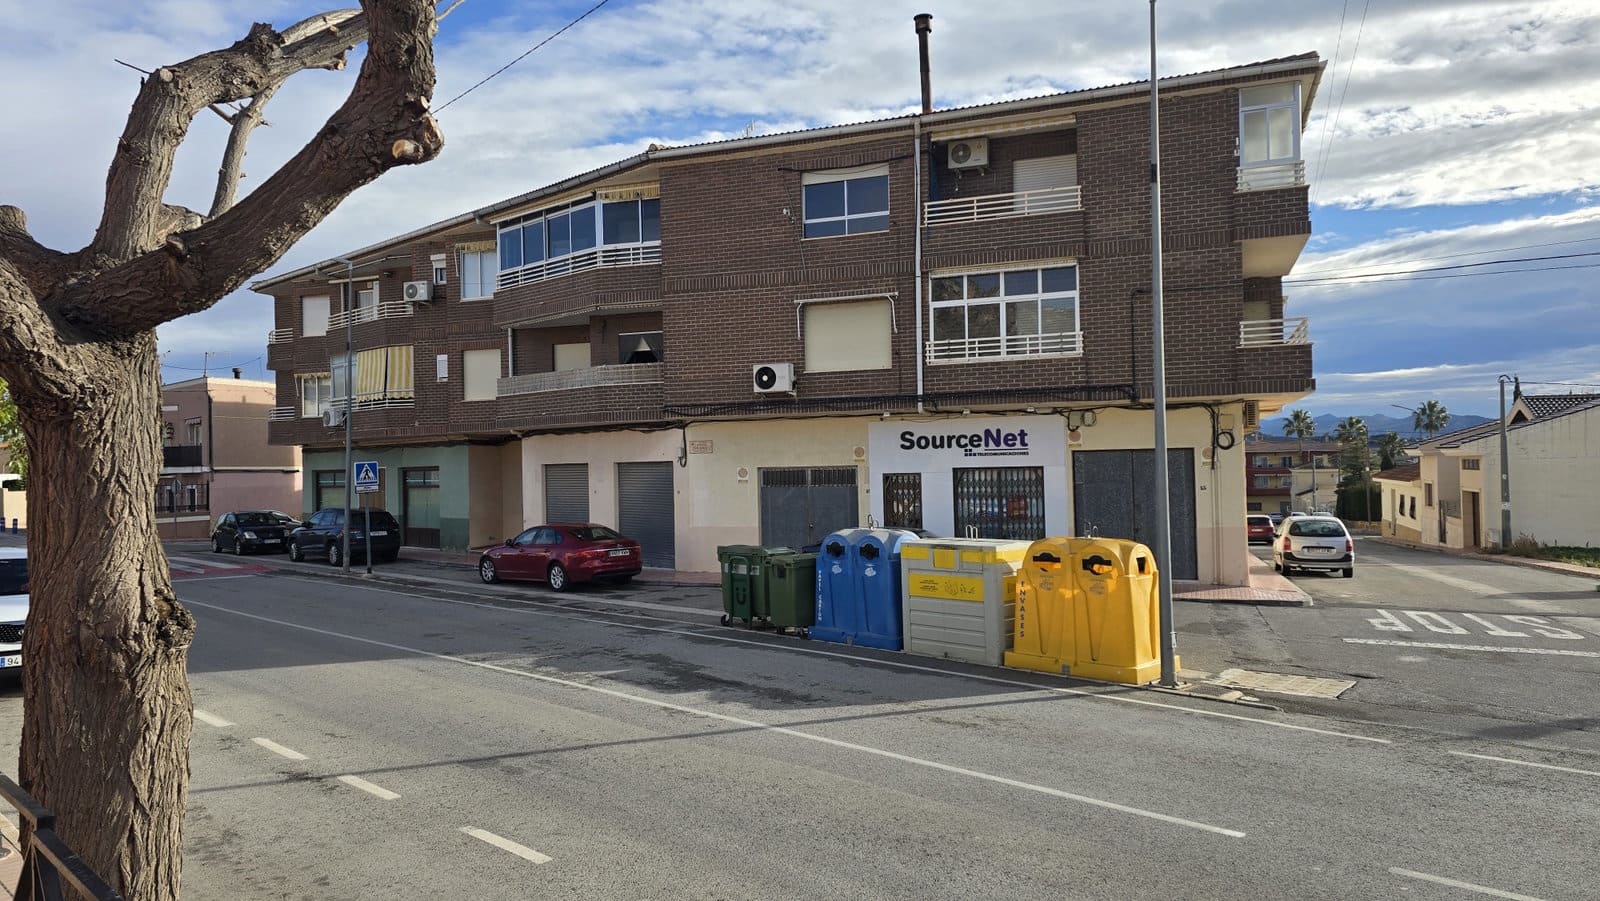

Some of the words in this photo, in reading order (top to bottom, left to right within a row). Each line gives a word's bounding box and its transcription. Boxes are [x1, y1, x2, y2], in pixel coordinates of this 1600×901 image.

[900, 428, 1029, 450] SourceNet
[1019, 581, 1027, 638] ENVASES
[1367, 608, 1585, 640] STOP
